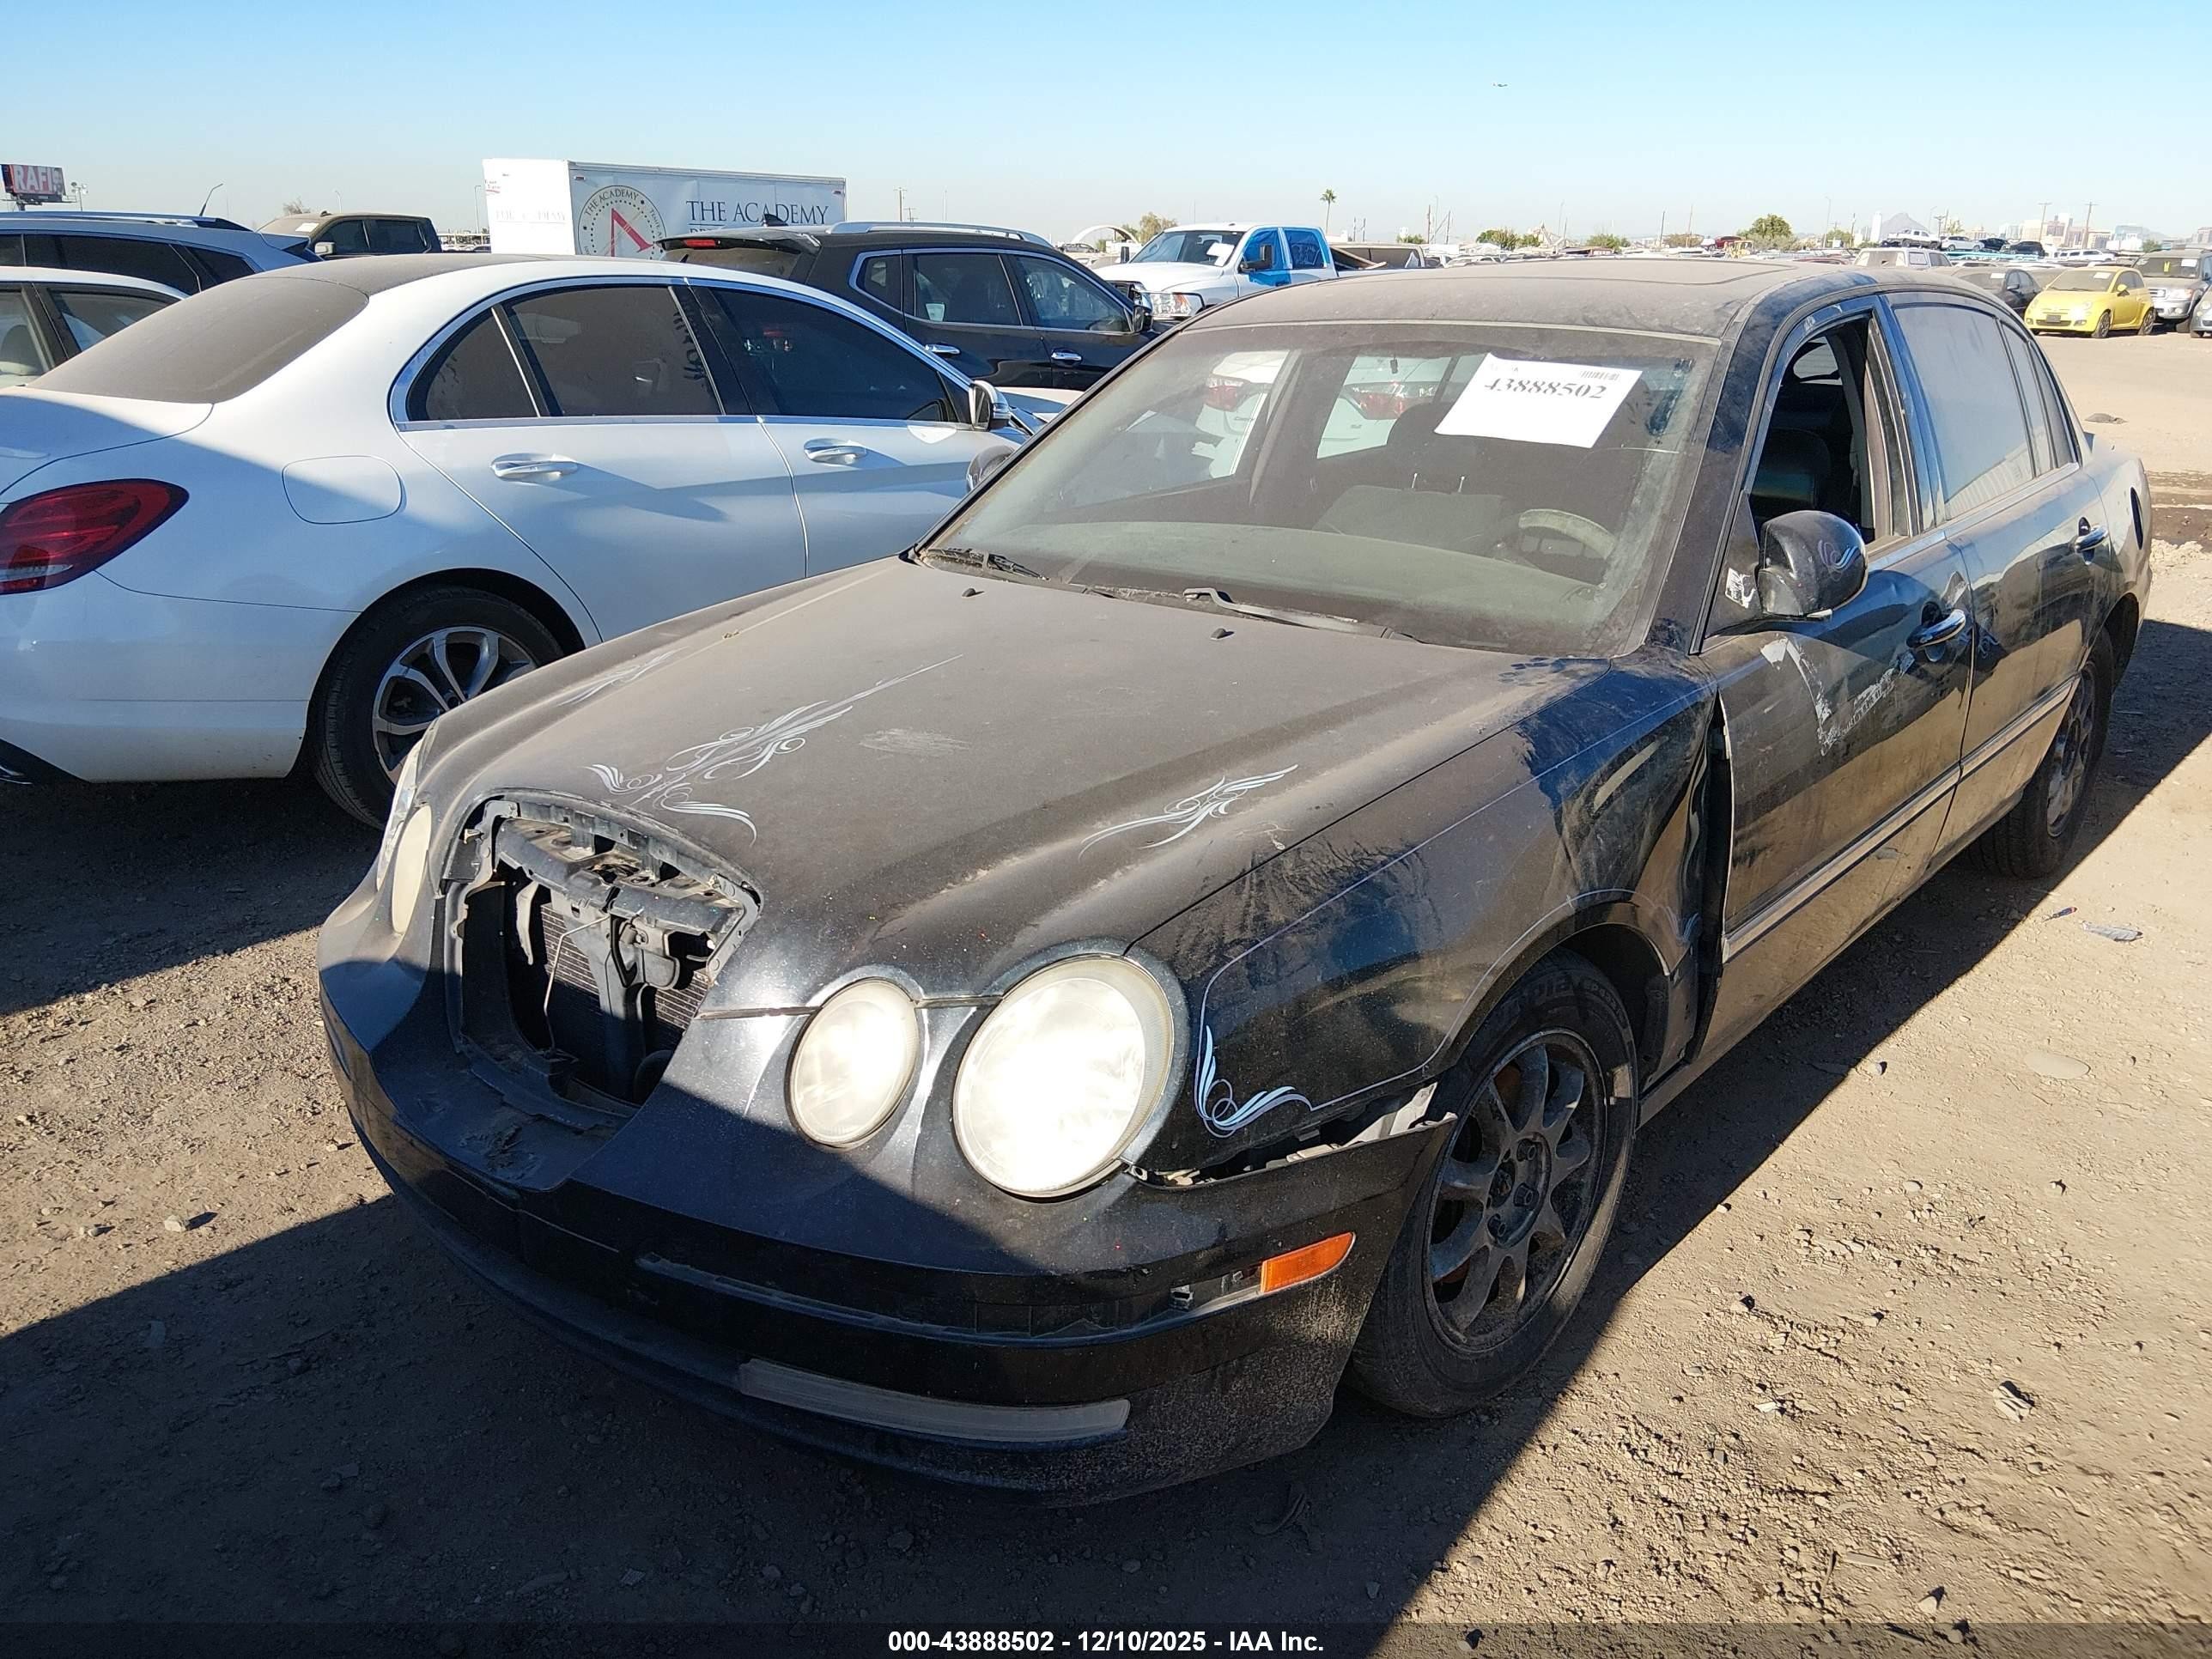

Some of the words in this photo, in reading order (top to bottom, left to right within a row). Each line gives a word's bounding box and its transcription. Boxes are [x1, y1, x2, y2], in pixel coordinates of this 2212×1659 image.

[585, 198, 599, 216] THE
[599, 188, 639, 203] ACADEMY
[686, 200, 727, 222] THE
[732, 202, 830, 225] ACADEMY
[1485, 378, 1607, 399] 43888502
